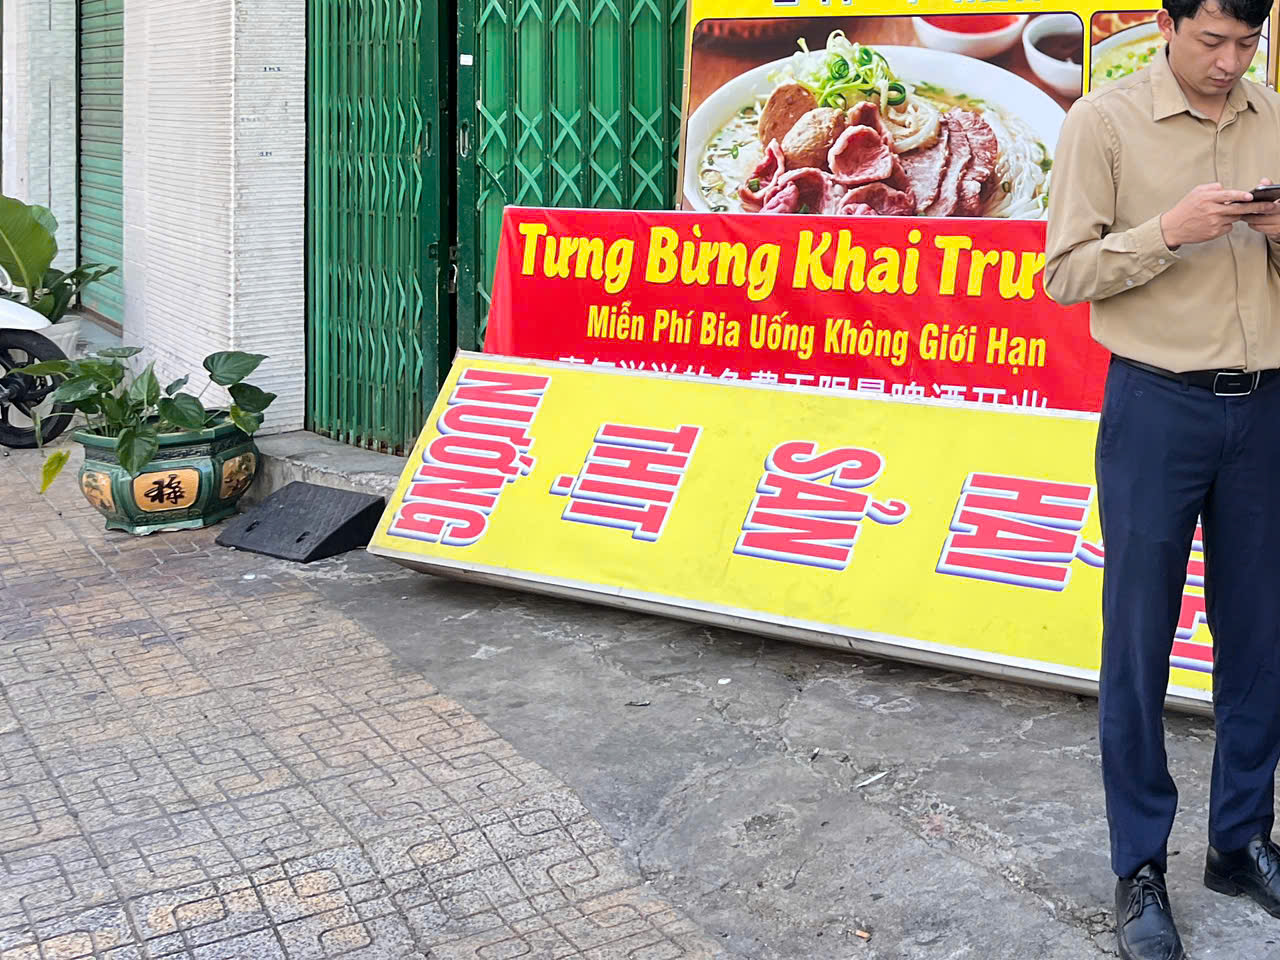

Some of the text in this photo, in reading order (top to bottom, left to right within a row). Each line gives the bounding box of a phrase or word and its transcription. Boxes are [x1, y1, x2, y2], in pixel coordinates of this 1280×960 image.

[519, 222, 1054, 301] Tưng Bừng Khai Trư
[587, 301, 1047, 375] Miễn Phí Bia Uống Không Giới Hạn
[389, 368, 550, 544] NƯỚNG
[551, 424, 701, 539] THỊT
[735, 440, 908, 567] SẢN
[940, 472, 1104, 588] HẢI
